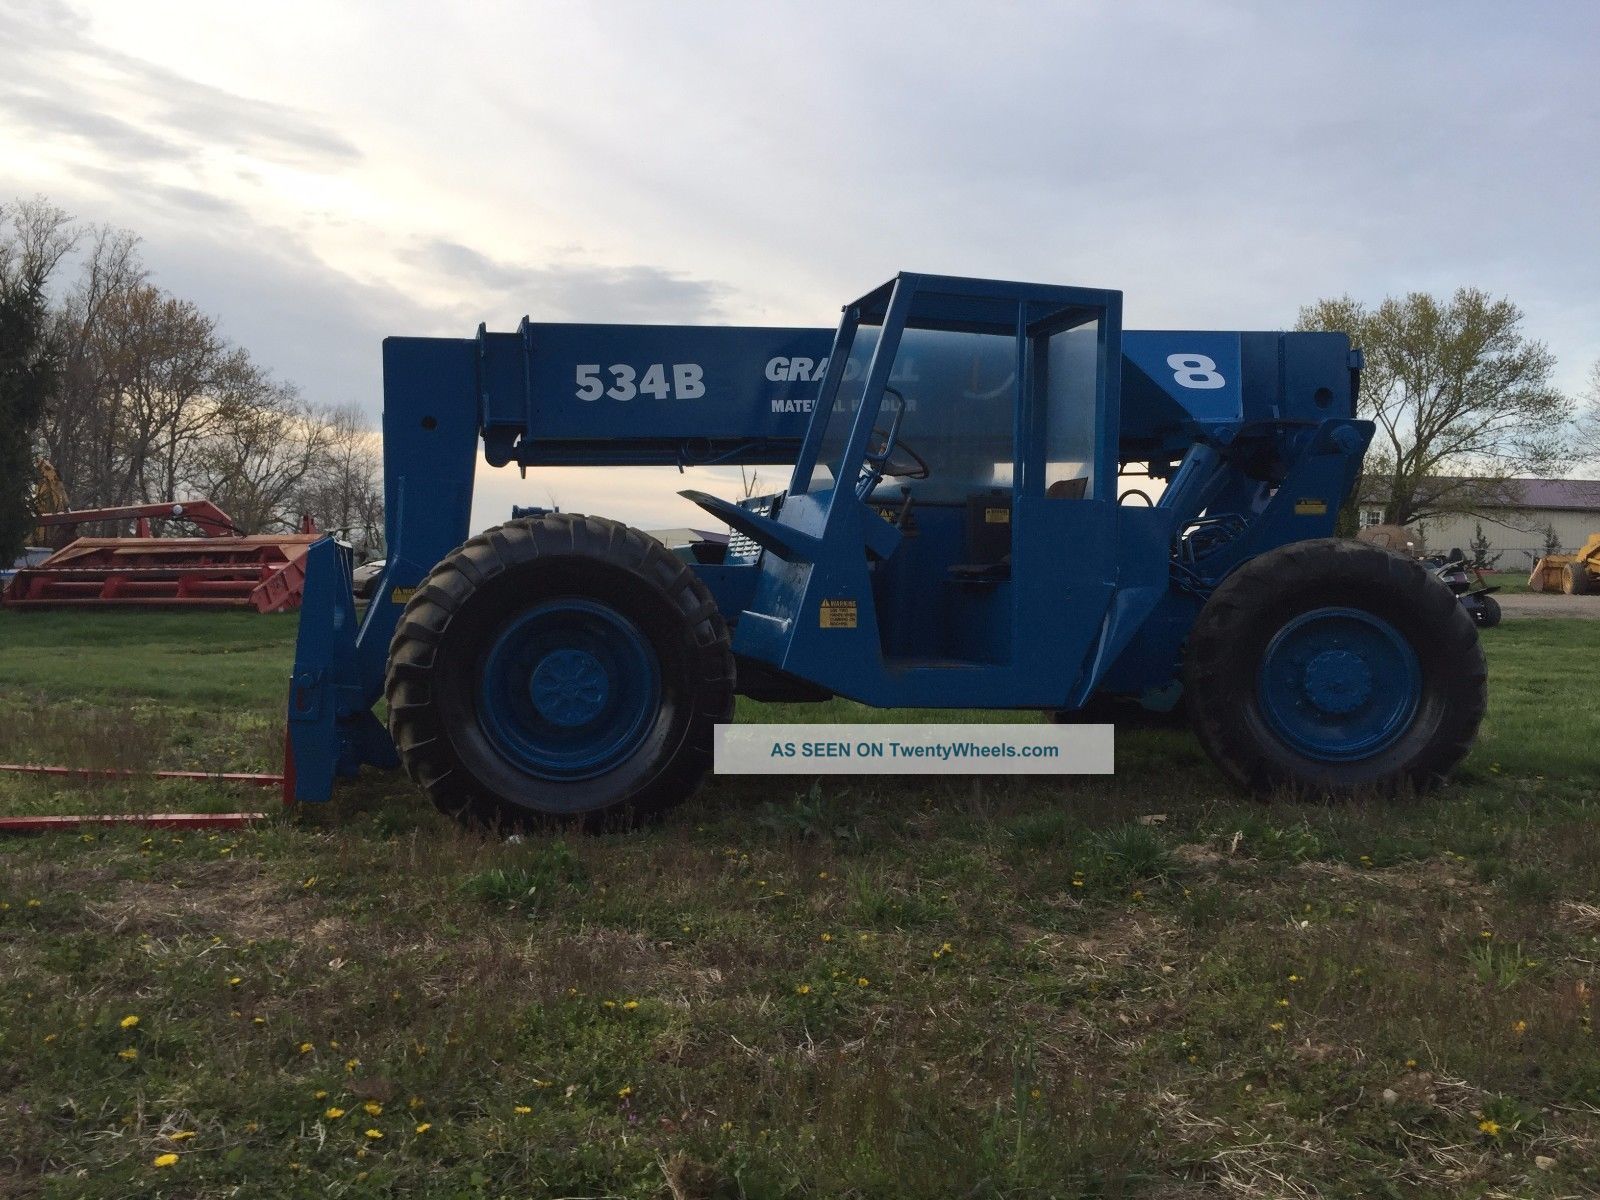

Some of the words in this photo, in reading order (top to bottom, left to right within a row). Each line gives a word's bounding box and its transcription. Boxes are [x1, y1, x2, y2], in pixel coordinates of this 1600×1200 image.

[575, 363, 706, 402] 534B
[765, 356, 920, 382] GRADLL
[1166, 353, 1226, 390] 8
[771, 399, 845, 413] MATEAL
